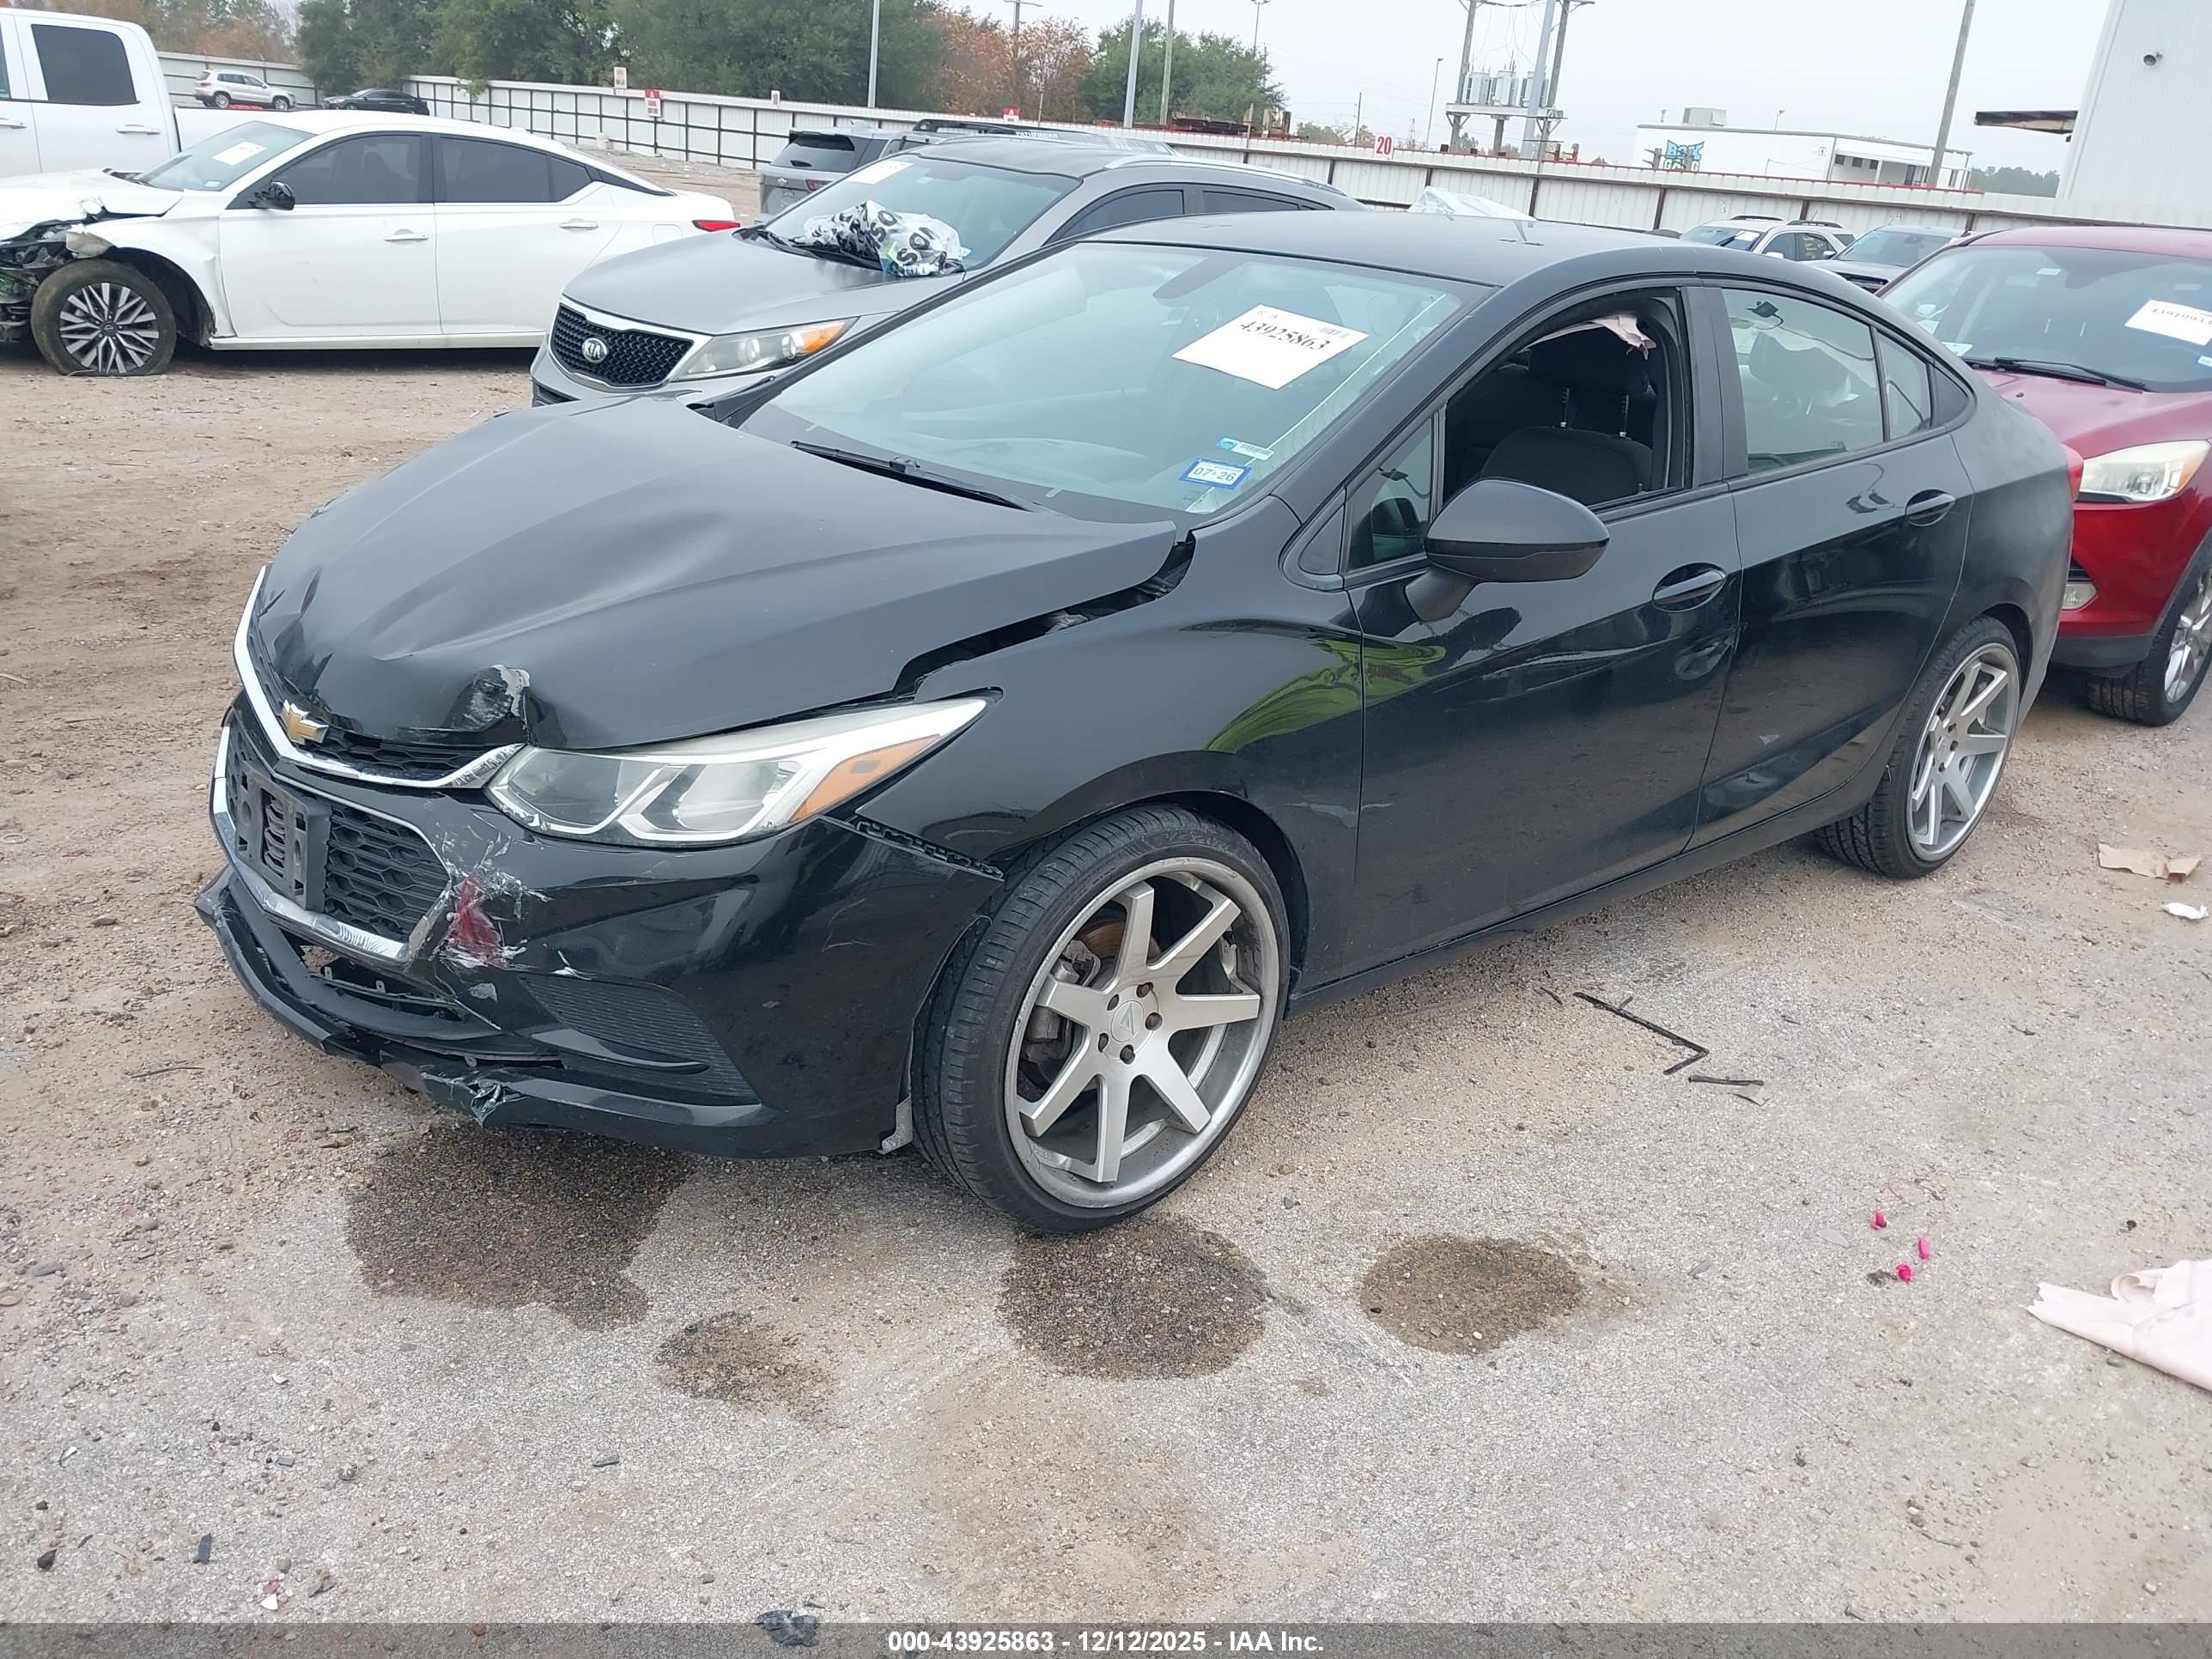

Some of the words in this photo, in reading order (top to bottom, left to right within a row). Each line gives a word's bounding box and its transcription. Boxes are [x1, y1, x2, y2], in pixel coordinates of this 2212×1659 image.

[1015, 131, 1059, 140] PATHFINDER
[1376, 136, 1392, 155] 20
[1239, 320, 1331, 350] 43925863
[583, 341, 601, 359] KIA
